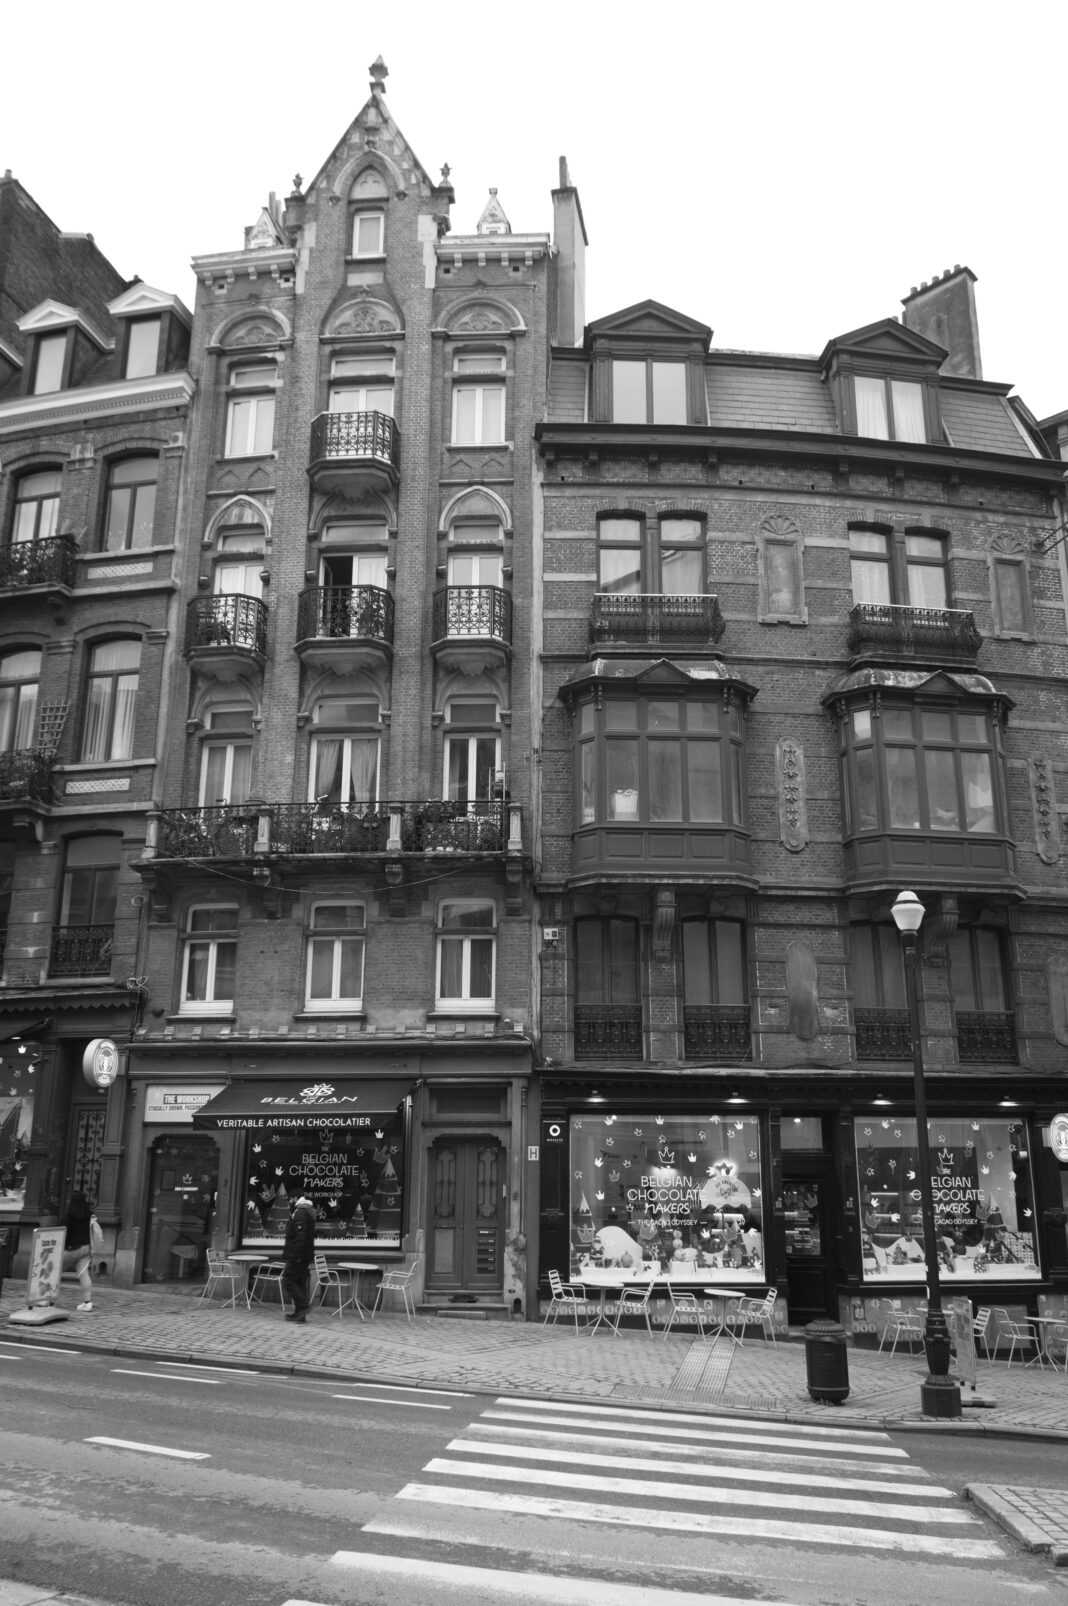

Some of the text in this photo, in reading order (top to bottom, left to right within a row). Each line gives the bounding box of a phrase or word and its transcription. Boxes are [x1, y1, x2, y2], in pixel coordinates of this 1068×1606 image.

[164, 1095, 210, 1104] THE WORKSHOP
[217, 1117, 371, 1128] VERITABLE ARTISAN CHOCOLATIER
[302, 1153, 348, 1164] BELGIAN
[289, 1165, 360, 1176] CHOCOLATE
[303, 1177, 344, 1188] MAKERS
[641, 1175, 692, 1187] BELGIAN
[931, 1176, 972, 1188] ELGIAN
[627, 1188, 707, 1201] CHOCOLATE
[645, 1202, 691, 1215] MAKERS
